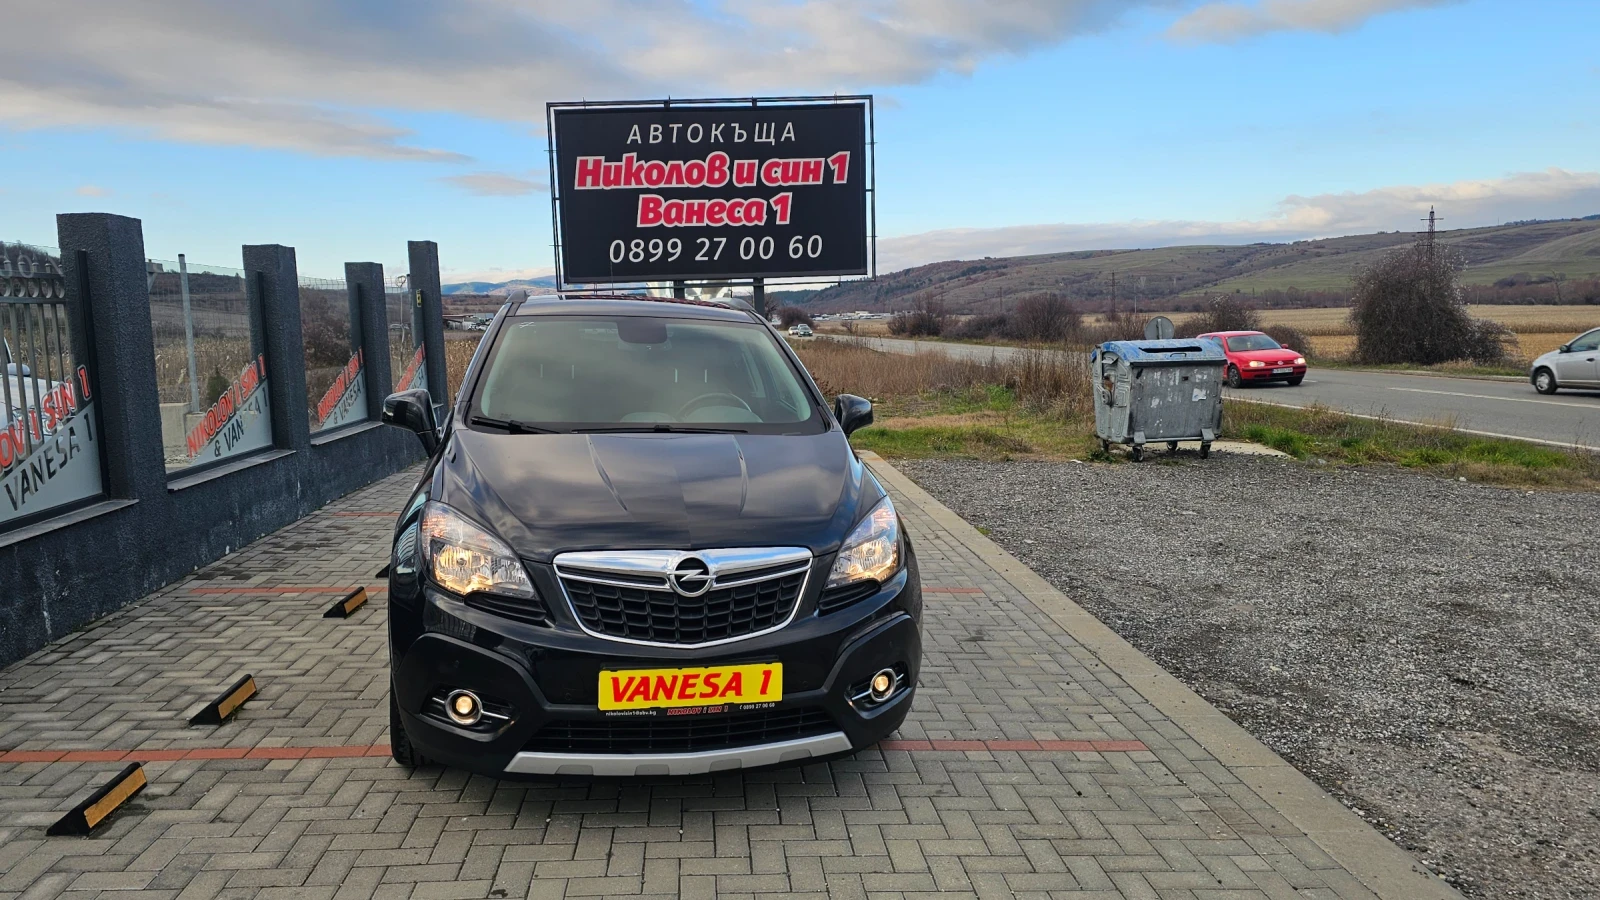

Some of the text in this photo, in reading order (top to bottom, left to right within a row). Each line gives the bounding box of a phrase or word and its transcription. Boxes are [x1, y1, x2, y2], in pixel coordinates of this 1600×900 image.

[627, 122, 796, 145] АВТОКЪЩА
[574, 151, 850, 190] Николов и син 1
[637, 192, 792, 227] Ванеса 1
[609, 235, 823, 263] 0899 27 00 60
[0, 365, 92, 471] OV I SIN 1
[186, 353, 266, 459] NIKOLOV I SIN 1
[4, 412, 93, 511] VANESA 1
[214, 440, 221, 457] &
[611, 670, 772, 702] VANESA 1
[667, 706, 702, 716] NIKOLOV
